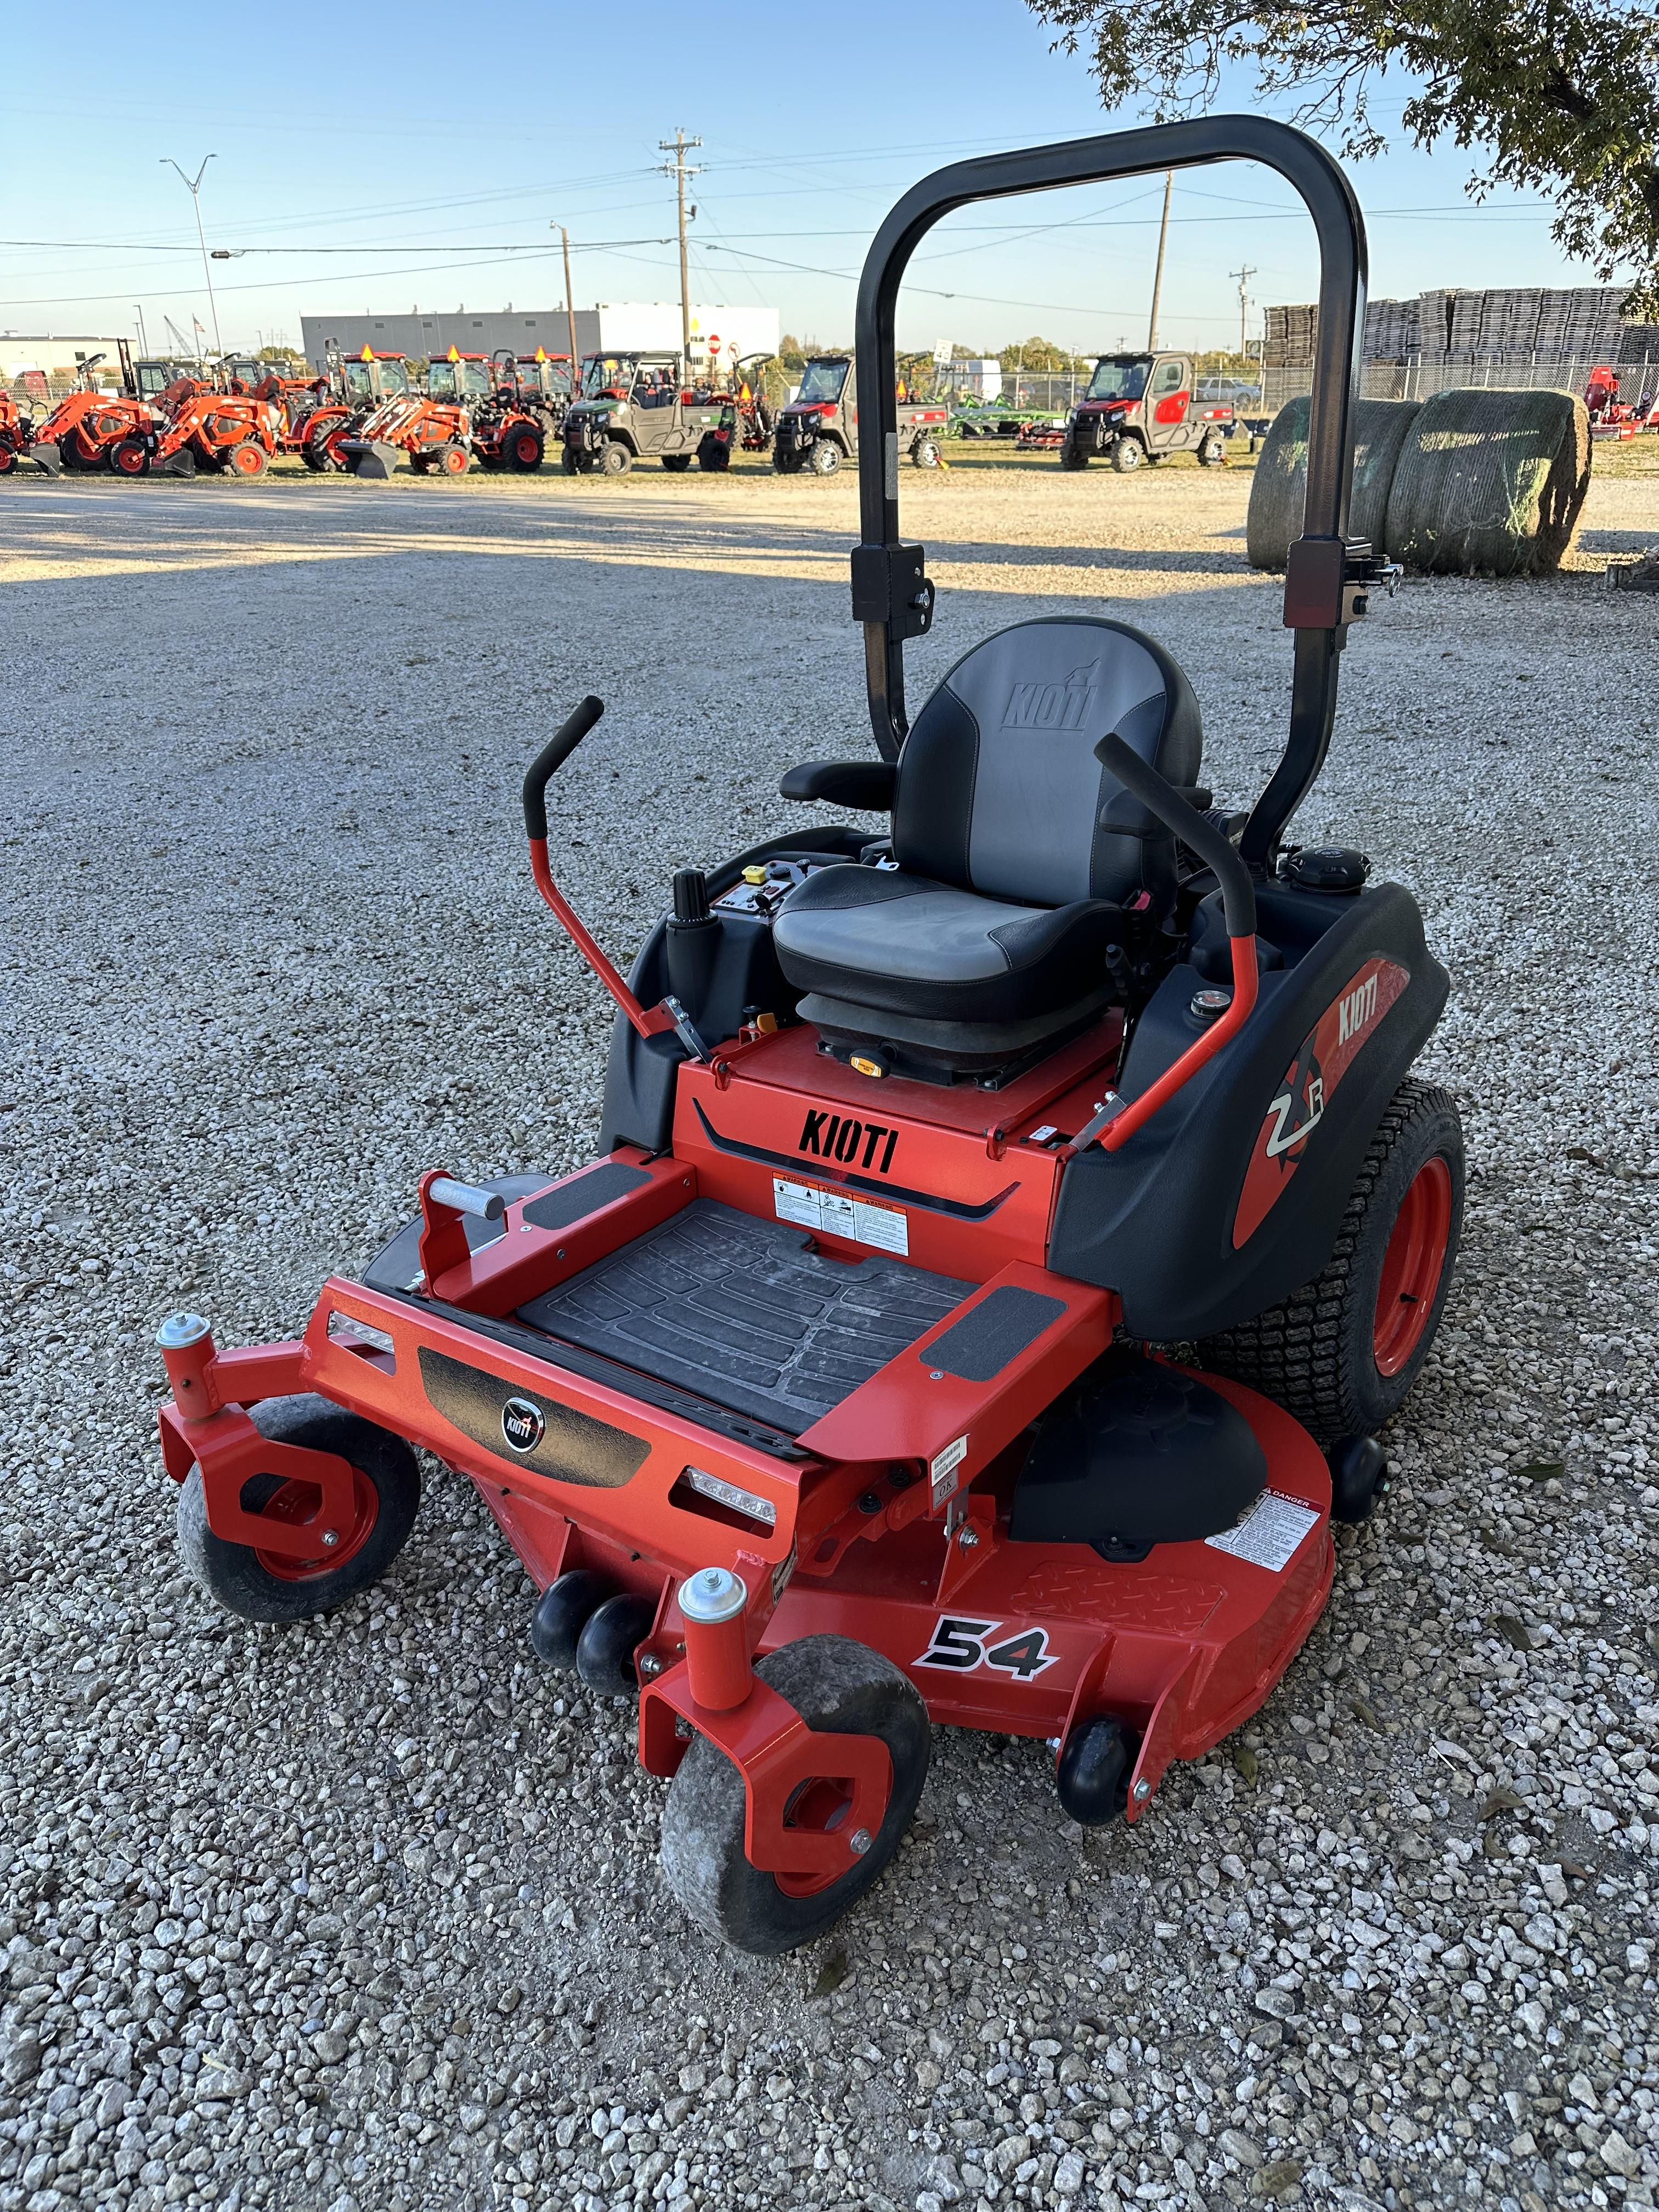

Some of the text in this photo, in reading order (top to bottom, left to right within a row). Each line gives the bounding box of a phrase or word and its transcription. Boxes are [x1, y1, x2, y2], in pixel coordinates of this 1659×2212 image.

[1001, 683, 1098, 729] KIOTI
[1339, 973, 1378, 1046] KIOTI
[798, 1109, 899, 1174] KIOTI
[786, 1176, 808, 1186] WARNING
[827, 1187, 849, 1198] WARNING
[870, 1200, 894, 1210] WARNING
[506, 1416, 532, 1438] KIOTI
[939, 1477, 953, 1497] OK
[1272, 1491, 1310, 1507] DANGER
[913, 1616, 1058, 1680] 54
